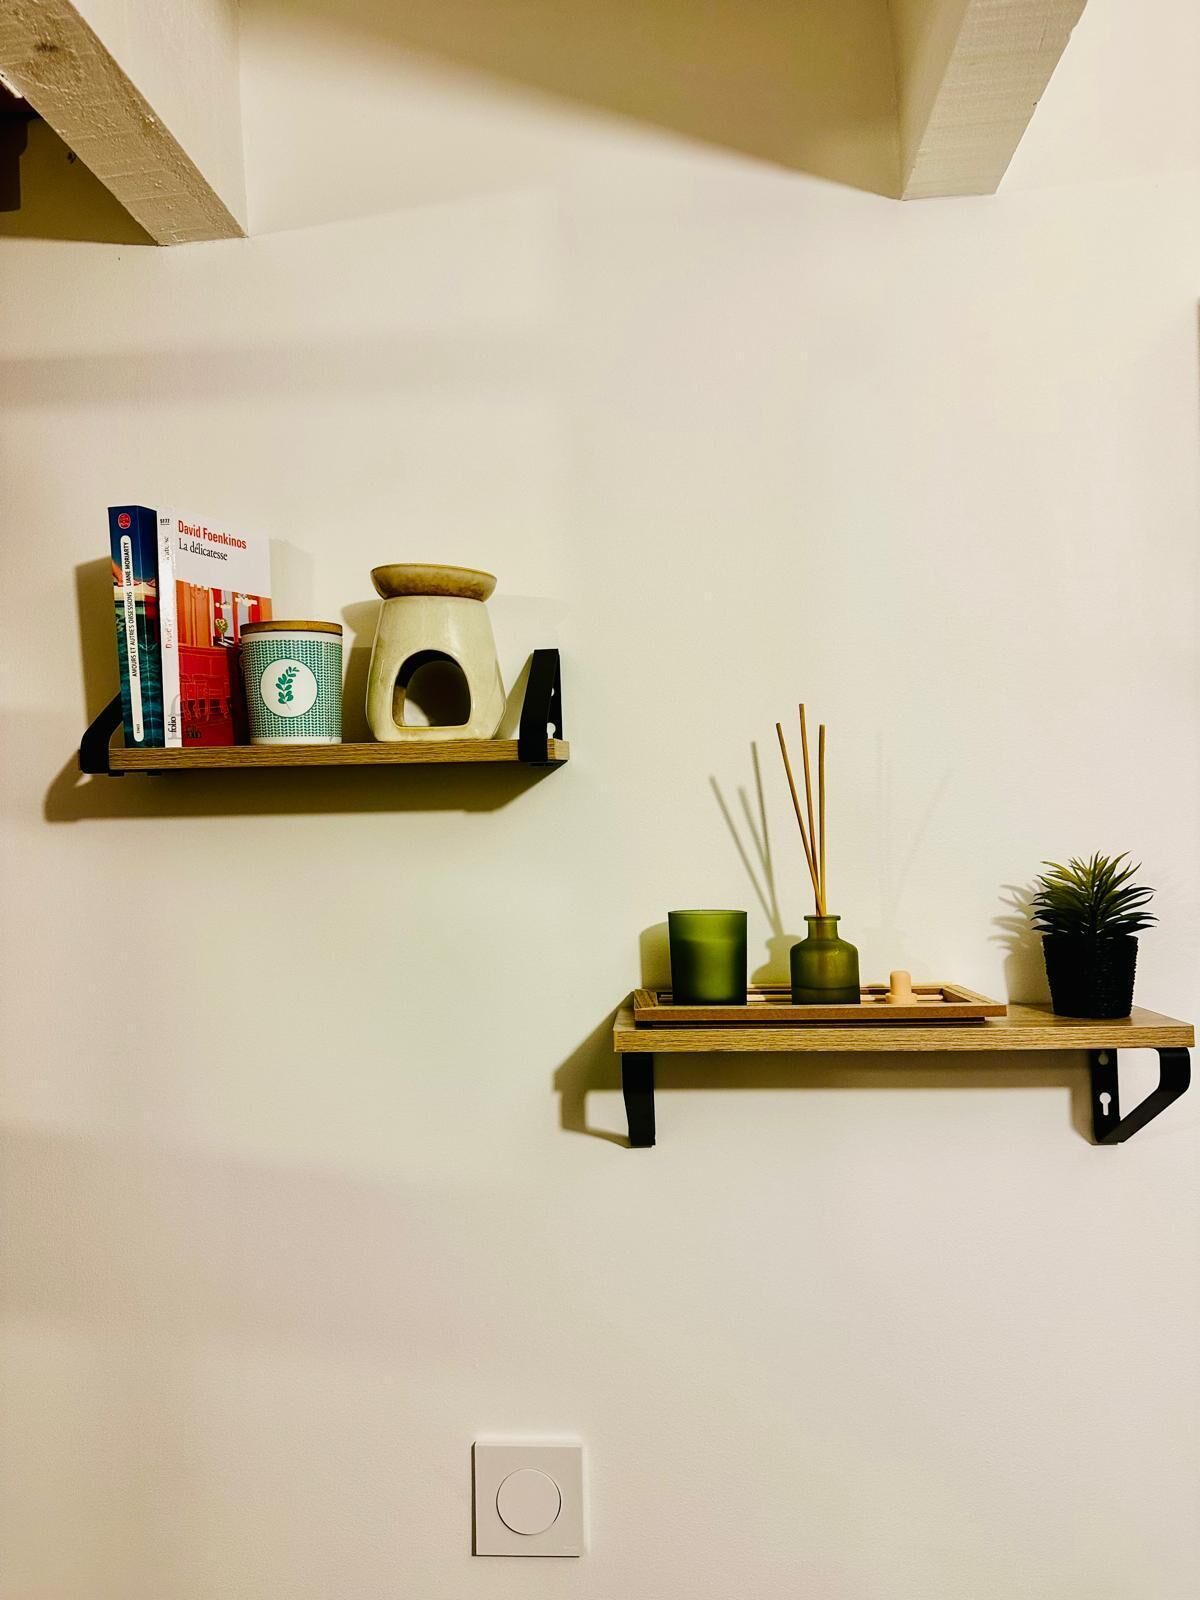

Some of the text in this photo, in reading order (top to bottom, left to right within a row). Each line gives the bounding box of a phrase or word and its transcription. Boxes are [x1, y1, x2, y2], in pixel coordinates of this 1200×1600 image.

[178, 520, 247, 550] David Foenkinos
[123, 542, 131, 570] MORIARTY
[178, 537, 188, 552] La
[190, 541, 228, 561] délicatesse
[130, 655, 138, 677] AMOURS
[167, 716, 177, 733] folio
